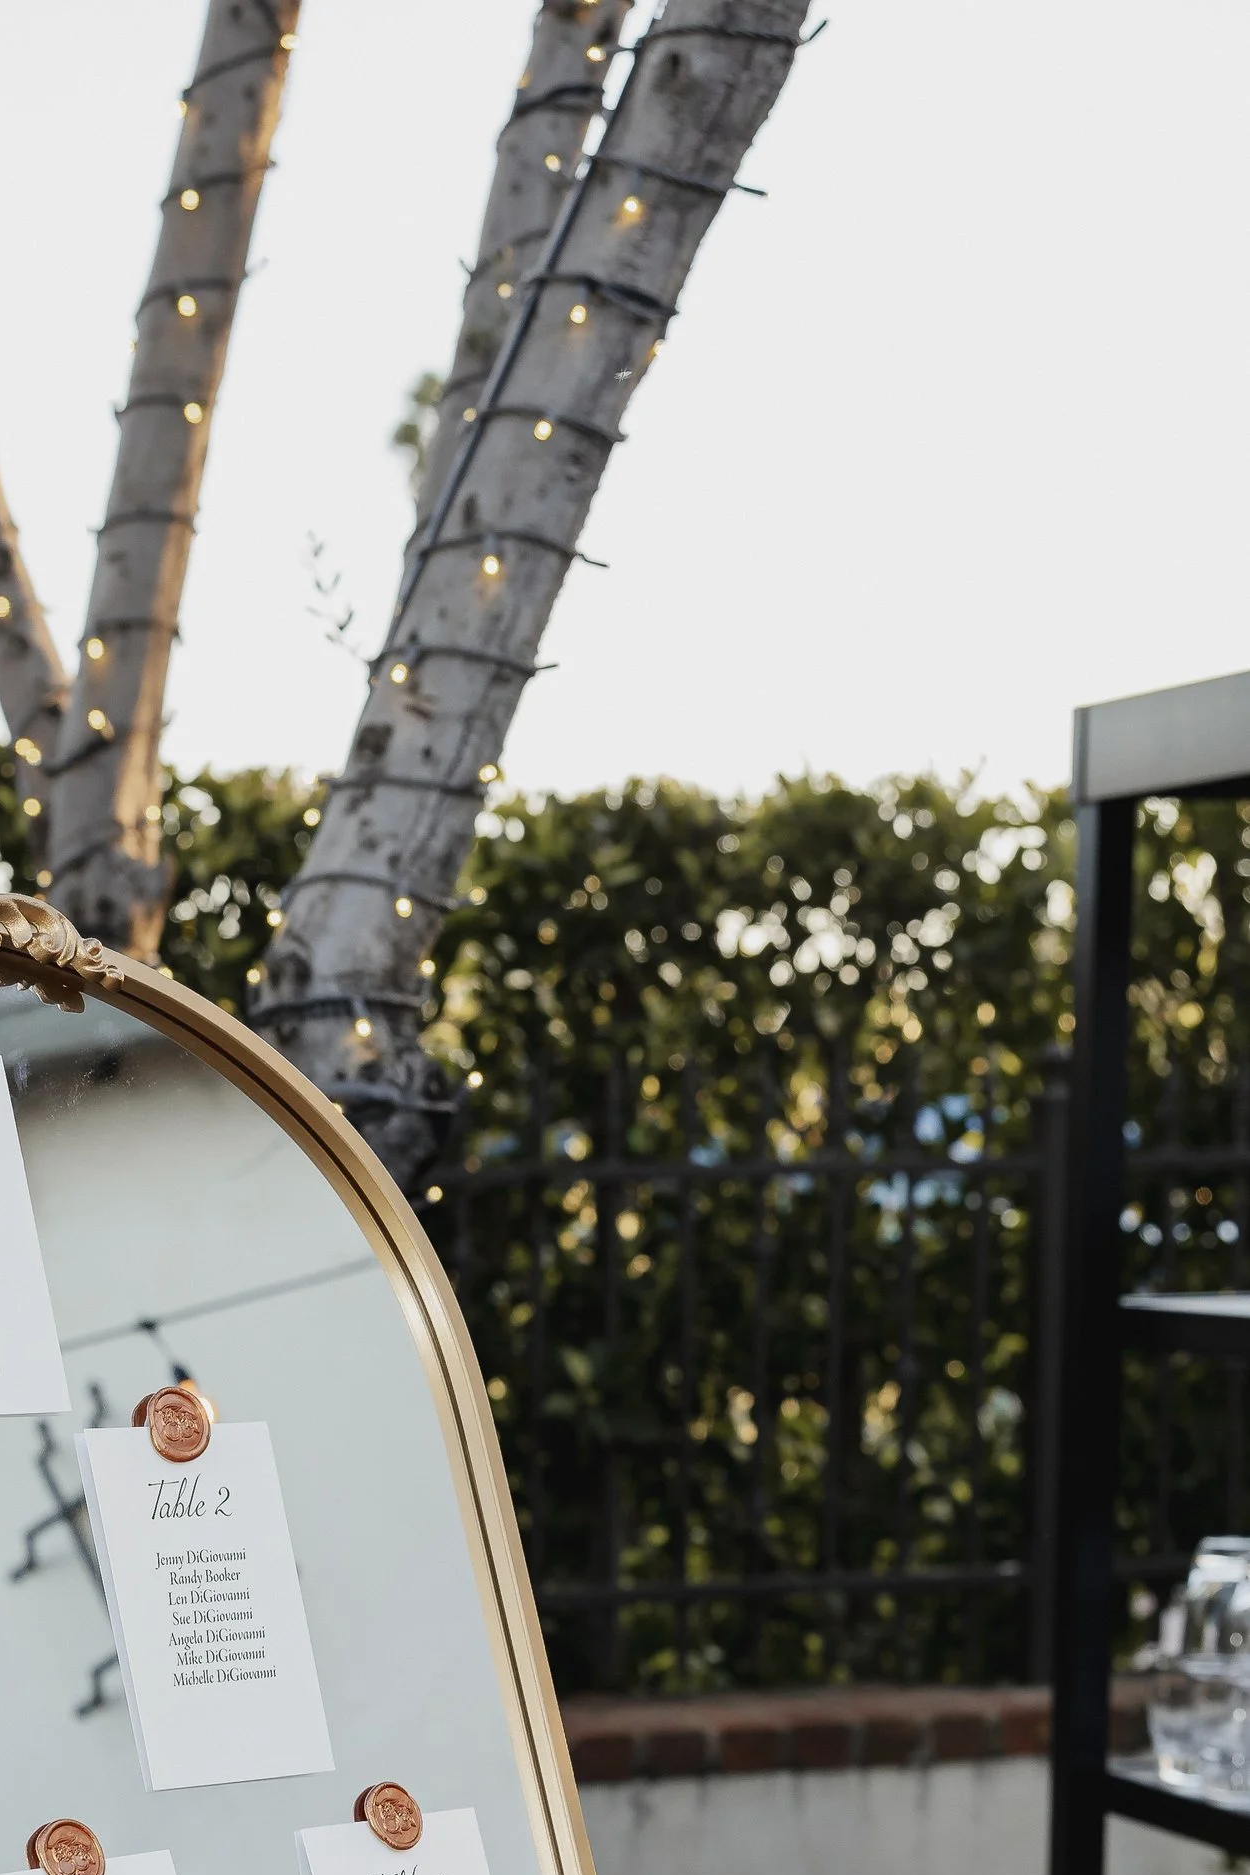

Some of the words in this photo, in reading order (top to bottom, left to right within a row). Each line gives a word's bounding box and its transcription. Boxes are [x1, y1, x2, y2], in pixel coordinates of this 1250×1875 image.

[147, 1473, 207, 1521] Table
[214, 1486, 234, 1518] 2
[154, 1552, 184, 1571] Jenny
[185, 1547, 246, 1565] DiGiovanni
[169, 1569, 203, 1589] Randy
[204, 1566, 241, 1583] Booker
[167, 1591, 188, 1606] Len
[190, 1587, 250, 1605] DiGiovanni
[172, 1611, 191, 1626] Sue
[193, 1606, 253, 1625] DiGiovanni
[168, 1629, 204, 1651] Angela
[205, 1625, 266, 1644] DiGiovanni
[176, 1649, 203, 1667] Mike
[205, 1645, 265, 1664] DiGiovanni
[172, 1669, 215, 1687] Michelle
[216, 1664, 277, 1683] DiGiovanni
